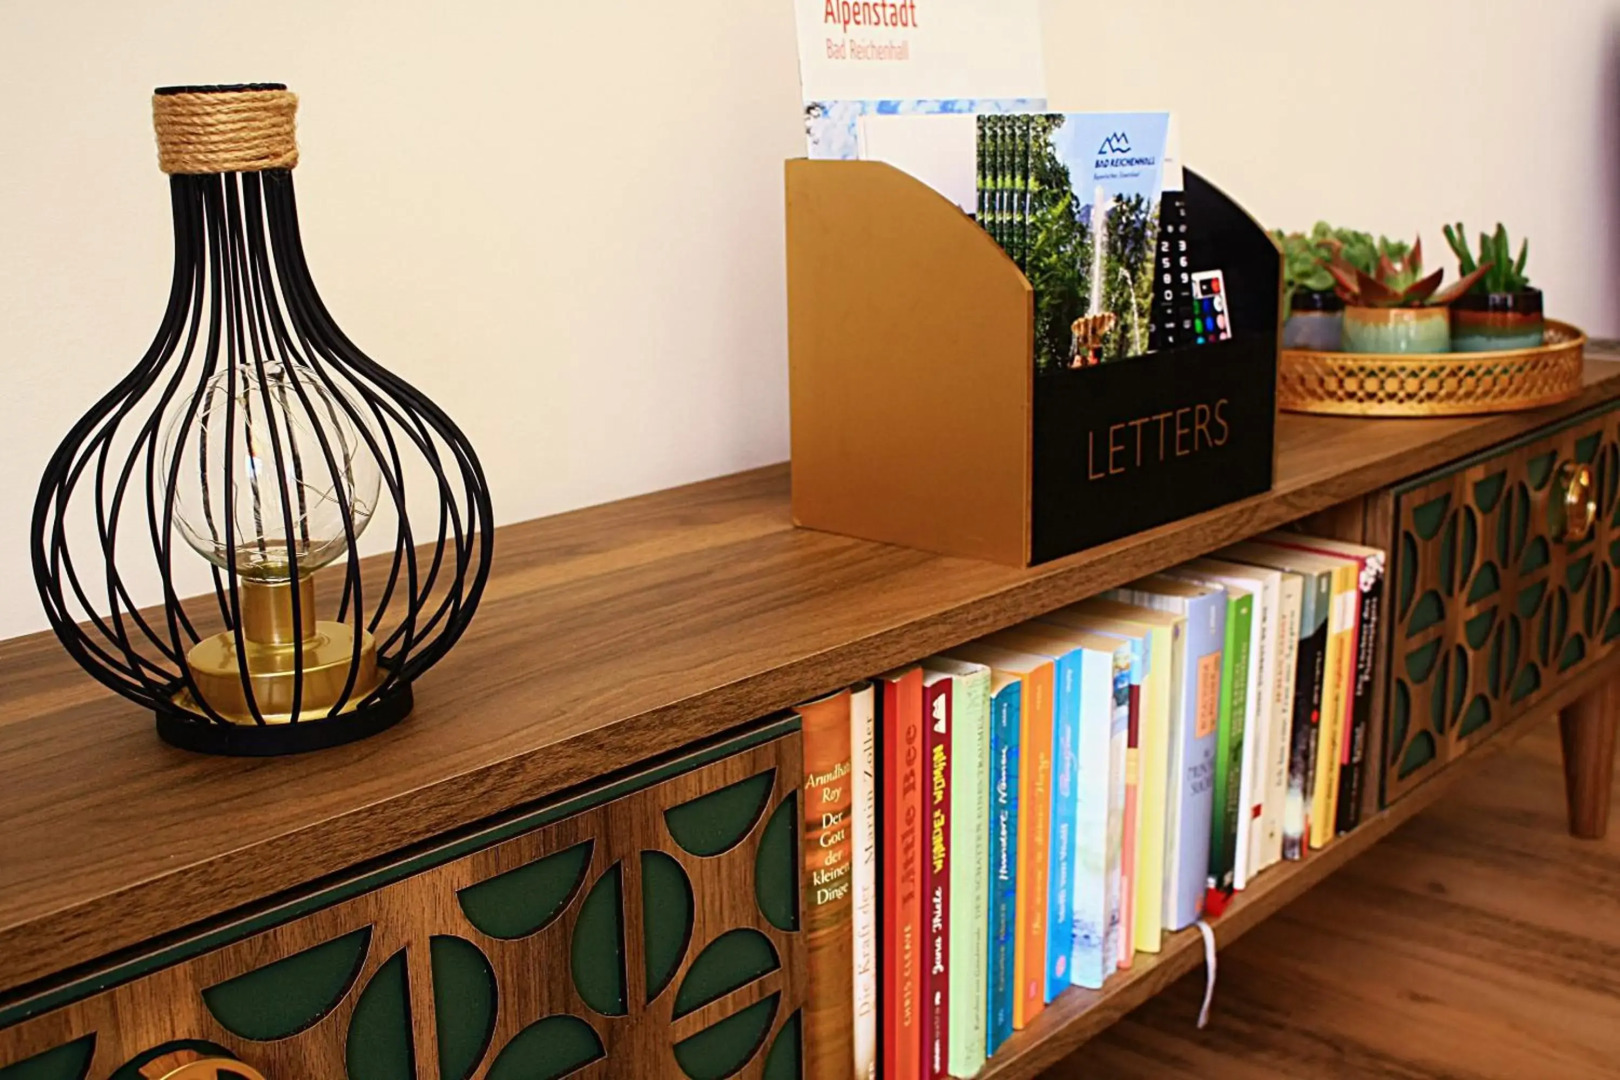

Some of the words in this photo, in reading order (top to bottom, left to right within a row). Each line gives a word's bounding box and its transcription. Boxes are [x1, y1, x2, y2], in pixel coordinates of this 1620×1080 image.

[824, 0, 918, 33] Alpenstadt
[826, 38, 847, 60] Bad
[849, 38, 910, 61] Reichenhall
[1095, 158, 1110, 169] BAD
[1161, 241, 1170, 252] 2
[1178, 240, 1187, 252] 3
[1162, 257, 1171, 269] 5
[1179, 256, 1188, 268] 6
[1164, 289, 1173, 301] 0
[1180, 272, 1189, 284] 9
[1088, 398, 1229, 480] LETTERS
[902, 723, 918, 800] Bee
[932, 743, 947, 805] WOMAN
[996, 745, 1008, 804] Namen
[822, 786, 842, 803] Roy
[822, 812, 843, 829] Der
[864, 789, 875, 866] Martin
[820, 829, 845, 848] Gott
[900, 804, 917, 907] Little
[932, 808, 946, 875] WANDER
[998, 809, 1009, 880] Hundert
[813, 861, 851, 887] kleinen
[824, 849, 843, 867] der
[817, 882, 849, 906] Dinge
[857, 886, 872, 914] der
[931, 886, 943, 933] Thiele
[856, 923, 872, 976] Kraft
[903, 924, 913, 977] CLEAVE
[931, 936, 945, 976] Jana
[856, 981, 872, 1018] Die
[903, 981, 913, 1028] CHRIS
